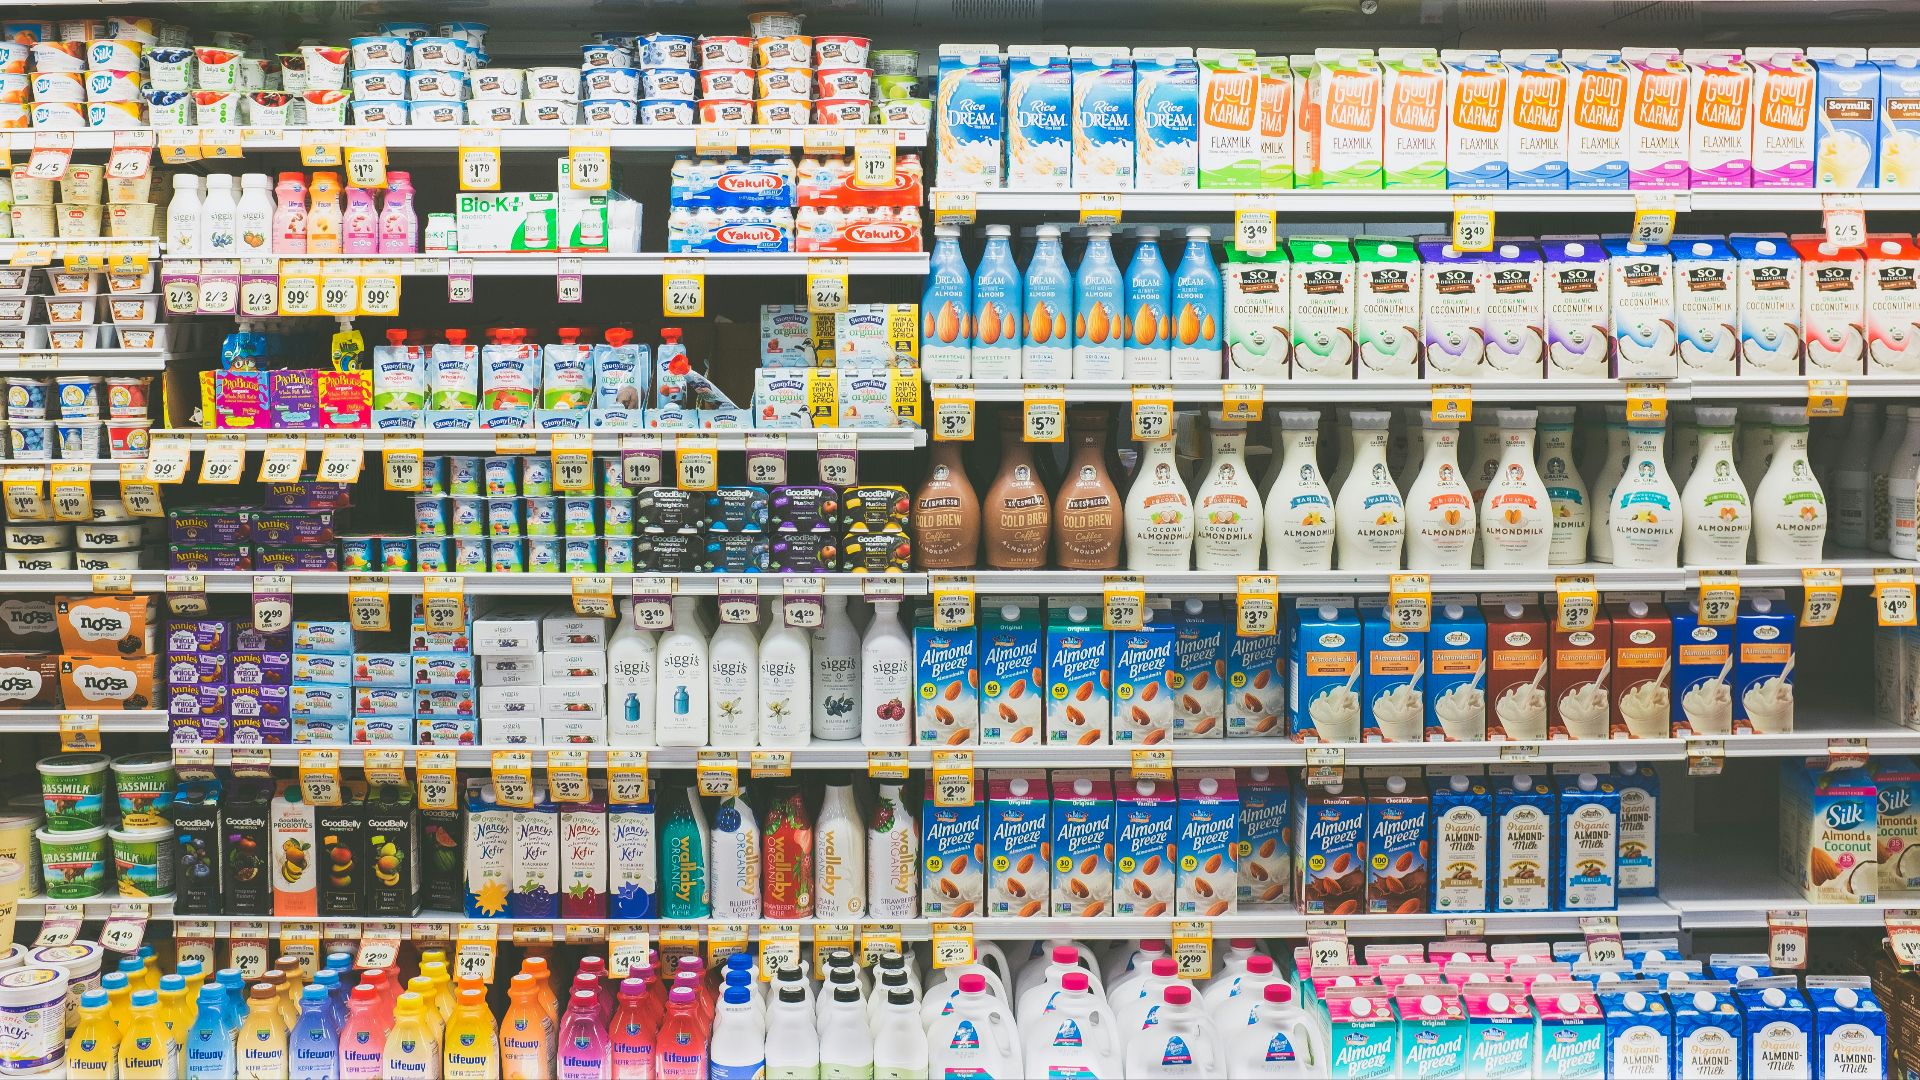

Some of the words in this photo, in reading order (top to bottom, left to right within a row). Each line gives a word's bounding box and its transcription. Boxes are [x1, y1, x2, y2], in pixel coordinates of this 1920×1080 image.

[92, 77, 112, 92] Silk
[1584, 74, 1622, 106] GOOD
[1706, 73, 1744, 105] GOOD
[1214, 74, 1252, 109] GOOD
[1462, 75, 1500, 107] GOOD
[960, 99, 986, 111] Rice
[1030, 101, 1056, 112] Rice
[1829, 100, 1870, 111] Soymilk
[950, 112, 994, 128] DREAM
[1019, 113, 1064, 129] DREAM
[1210, 105, 1250, 131] KARMA
[1460, 106, 1498, 128] KARMA
[1581, 105, 1619, 128] KARMA
[1702, 104, 1741, 126] KARMA
[1211, 136, 1250, 148] FLAXMILK
[1461, 138, 1499, 150] FLAXMILK
[1581, 137, 1620, 149] FLAXMILK
[1703, 136, 1742, 148] FLAXMILK
[729, 178, 773, 188] Yakult
[728, 230, 772, 240] Yakult
[856, 230, 902, 240] Yakult
[1632, 264, 1652, 273] SO
[1826, 269, 1845, 277] SO
[1250, 271, 1268, 279] SO
[1314, 271, 1333, 279] SO
[1234, 306, 1284, 314] COCONUTMILK
[1298, 306, 1349, 314] COCONUTMILK
[1811, 302, 1859, 311] COCONUTMILK
[850, 329, 883, 337] organic
[654, 491, 690, 499] GoodBelly
[858, 490, 894, 499] GoodBelly
[176, 517, 208, 529] Annie's
[1001, 514, 1024, 527] COLD
[1027, 513, 1047, 526] BREW
[1064, 514, 1086, 527] COLD
[1088, 513, 1112, 526] BREW
[1015, 531, 1040, 541] Coffee
[1076, 531, 1102, 542] Coffee
[1198, 532, 1253, 541] ALMONDMILK
[1487, 527, 1544, 536] ALMONDMILK
[1616, 526, 1674, 535] ALMONDMILK
[13, 533, 45, 545] noosa
[85, 533, 119, 545] noosa
[1065, 541, 1112, 555] ALMONDMILK
[81, 617, 122, 631] noosa
[921, 640, 973, 667] Almond
[1052, 641, 1105, 668] Almond
[664, 653, 700, 668] siggi's
[614, 661, 650, 676] siggi's
[873, 660, 908, 675] siggi's
[932, 657, 968, 678] Breeze
[1064, 659, 1100, 678] Breeze
[172, 686, 198, 695] Annie's
[1826, 802, 1864, 828] Silk
[175, 819, 214, 829] GoodBelly
[369, 819, 408, 829] GoodBelly
[994, 814, 1046, 840] Almond
[1507, 822, 1543, 831] Organic
[477, 824, 509, 841] Nancy's
[568, 825, 600, 841] Nancy's
[1508, 832, 1545, 841] ALMOND-
[1822, 831, 1865, 841] Almond
[1005, 829, 1041, 850] Breeze
[1513, 841, 1538, 850] Milk
[1824, 842, 1872, 852] Coconut
[44, 852, 98, 862] GRASSMILK
[480, 847, 504, 860] Kefir
[570, 848, 594, 860] Kefir
[671, 838, 680, 894] ORGANIC
[680, 836, 696, 902] wallaby
[768, 837, 776, 893] ORGANIC
[772, 837, 792, 902] wallaby
[189, 1049, 224, 1060] Lifeway
[298, 1049, 335, 1060] Lifeway
[1407, 1036, 1462, 1064] Almond
[1691, 1046, 1730, 1056] Organic
[70, 1058, 108, 1071] Lifeway
[564, 1056, 601, 1067] Lifeway
[1419, 1052, 1456, 1075] Breeze
[1692, 1057, 1732, 1066] ALMOND-
[1696, 1066, 1725, 1075] Milk
